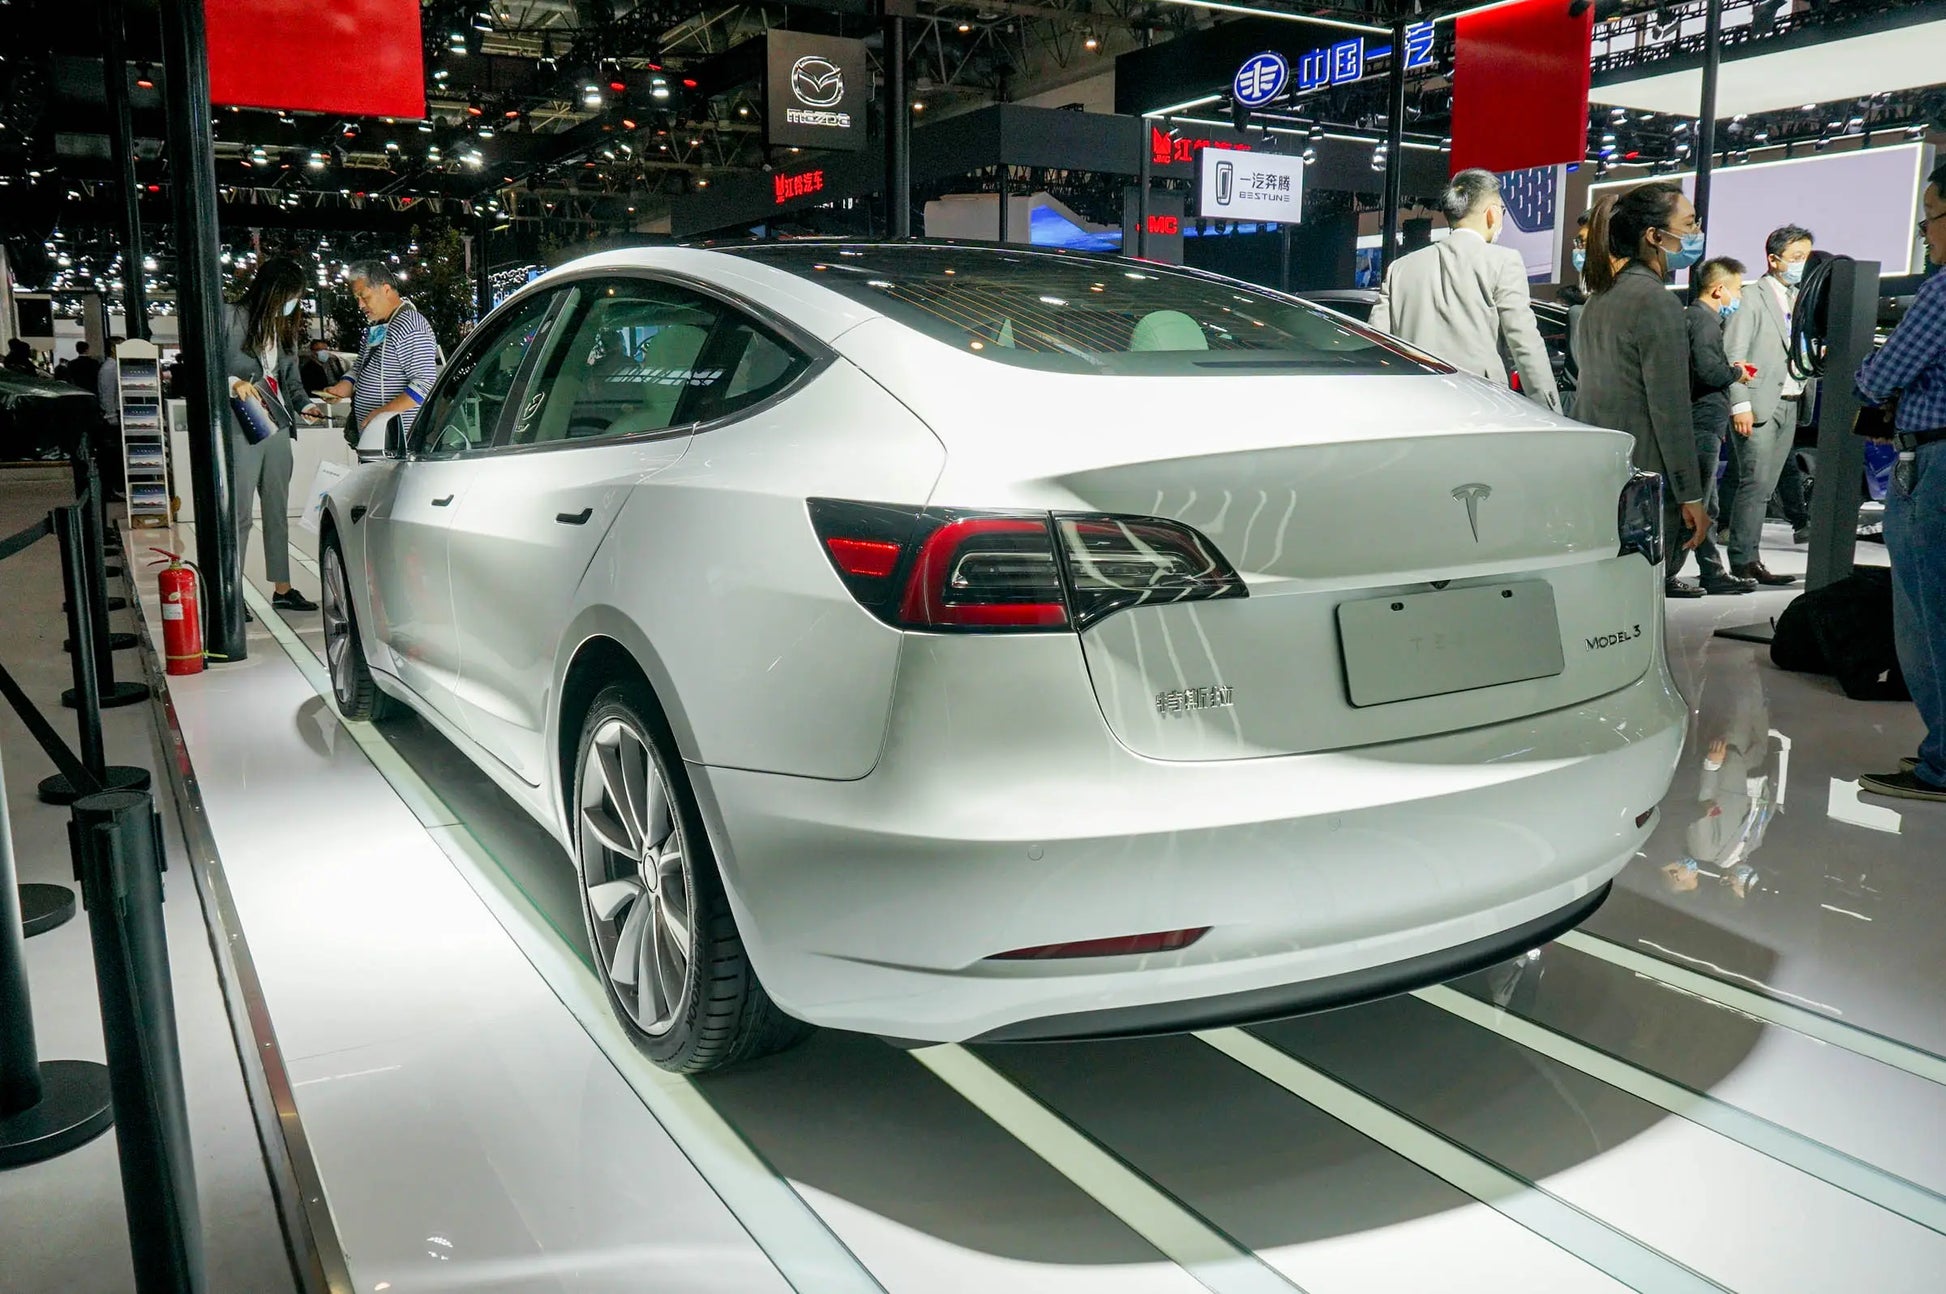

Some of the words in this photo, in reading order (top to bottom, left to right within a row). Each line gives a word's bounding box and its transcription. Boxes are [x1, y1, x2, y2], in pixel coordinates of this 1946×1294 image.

[1240, 172, 1290, 191] 一汽奔腾
[1239, 191, 1290, 202] BESTUNE
[1136, 215, 1179, 235] MC
[1585, 631, 1631, 651] MODEL
[1633, 624, 1641, 638] 3
